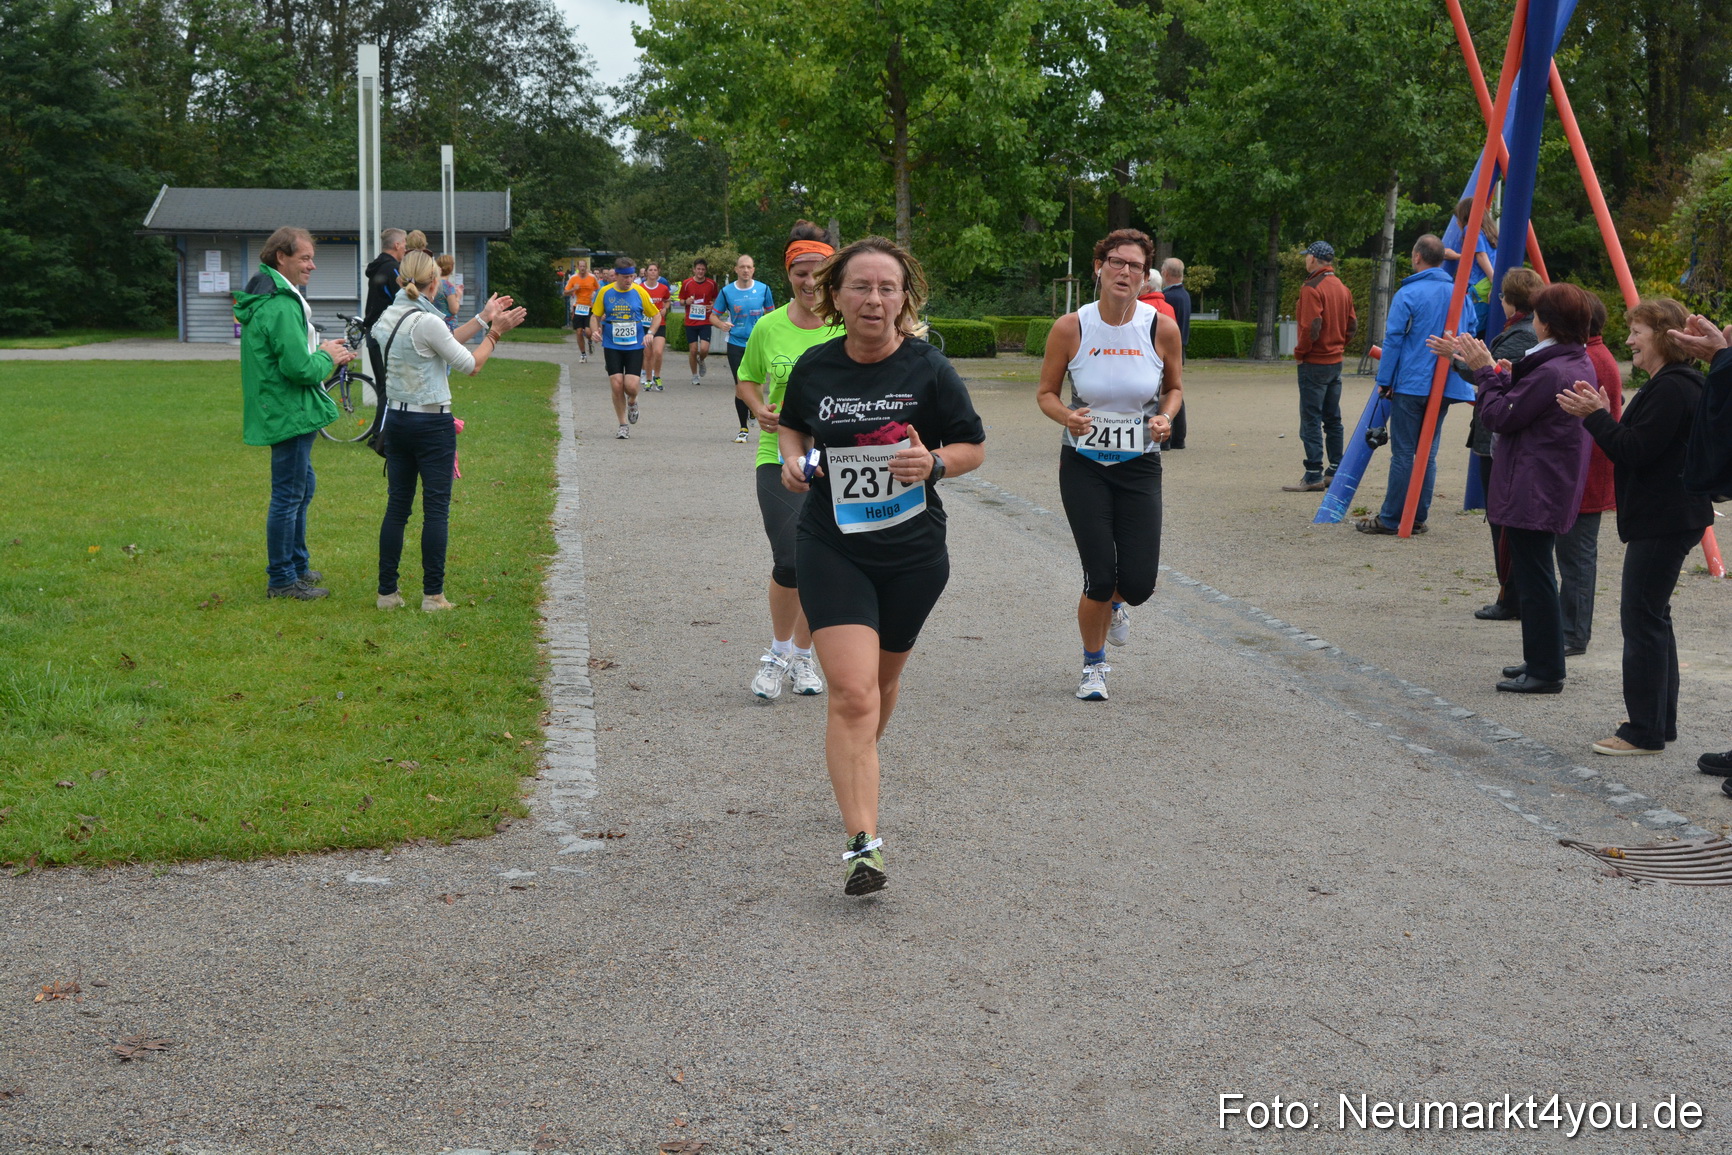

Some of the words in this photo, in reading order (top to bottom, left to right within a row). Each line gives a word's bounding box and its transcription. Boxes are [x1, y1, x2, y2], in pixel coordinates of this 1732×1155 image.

[614, 328, 635, 337] 2235
[1085, 425, 1135, 449] 2411
[829, 455, 861, 464] PARTL
[840, 467, 914, 499] 237
[865, 503, 901, 519] Helga
